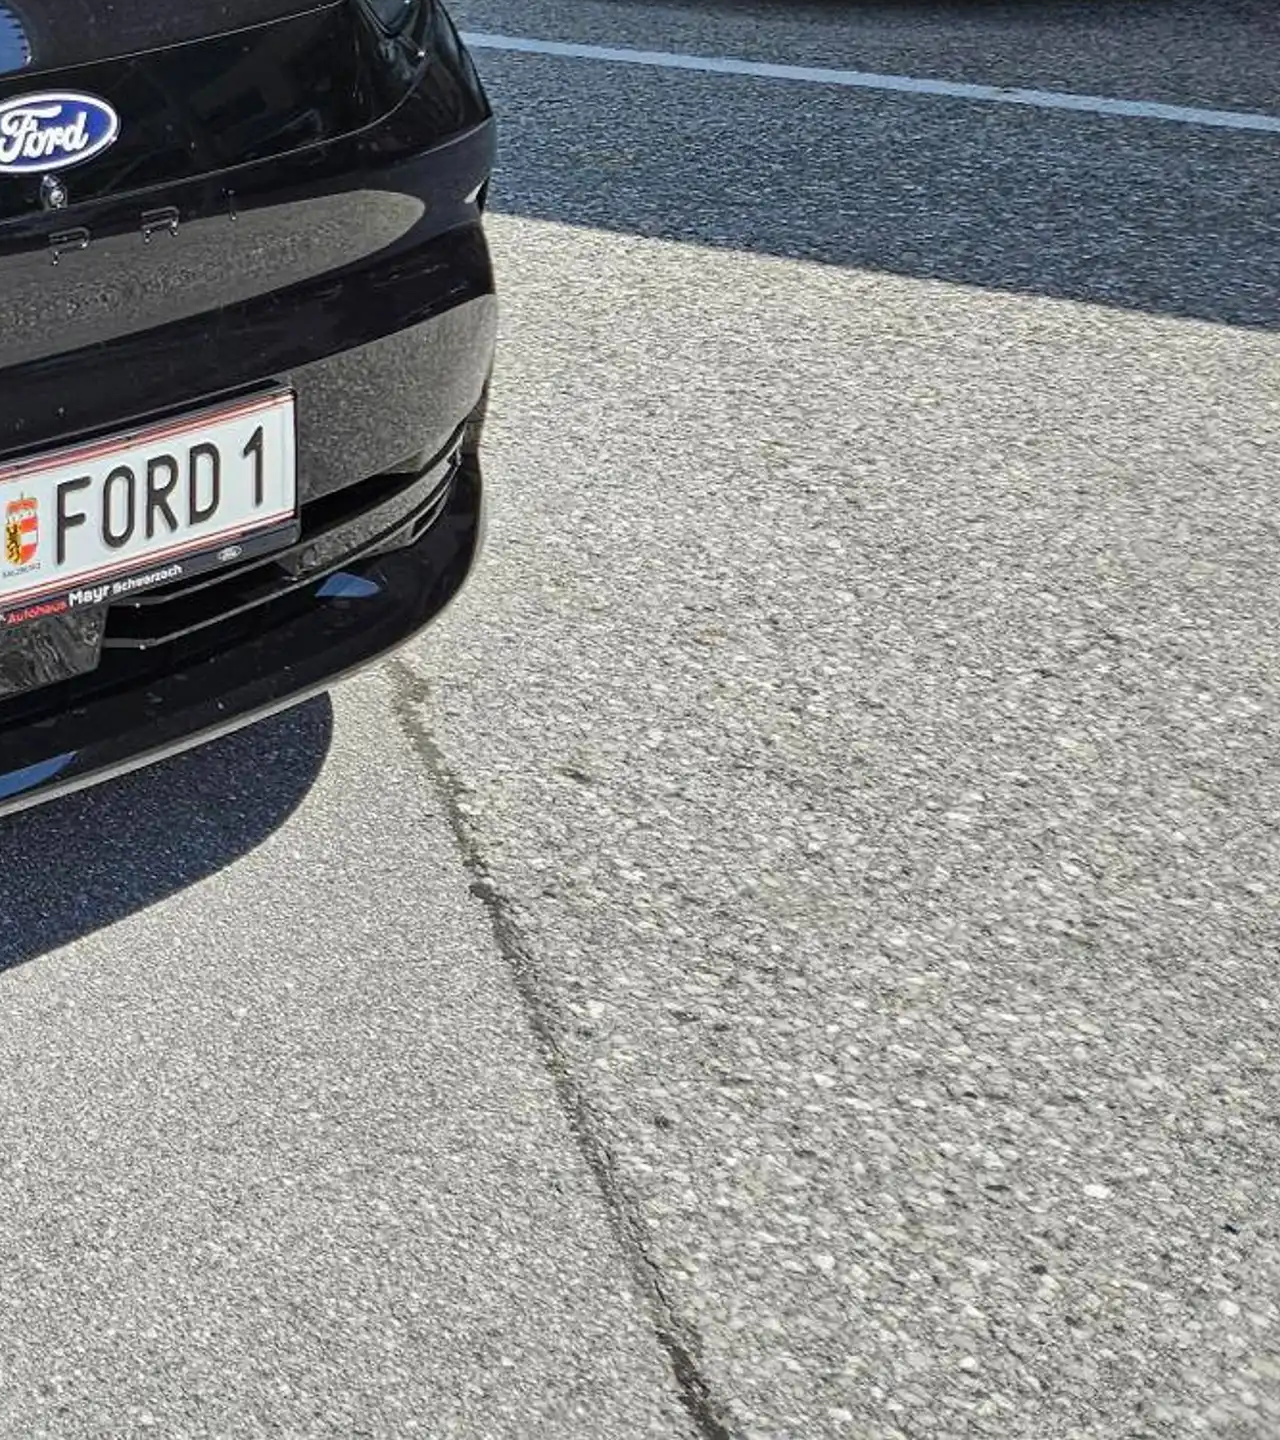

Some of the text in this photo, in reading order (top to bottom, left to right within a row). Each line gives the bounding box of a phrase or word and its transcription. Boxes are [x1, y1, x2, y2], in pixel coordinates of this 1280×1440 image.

[55, 441, 221, 566] FORD
[243, 424, 264, 507] 1
[8, 563, 184, 626] Autohaus Mayr Schwarzach
